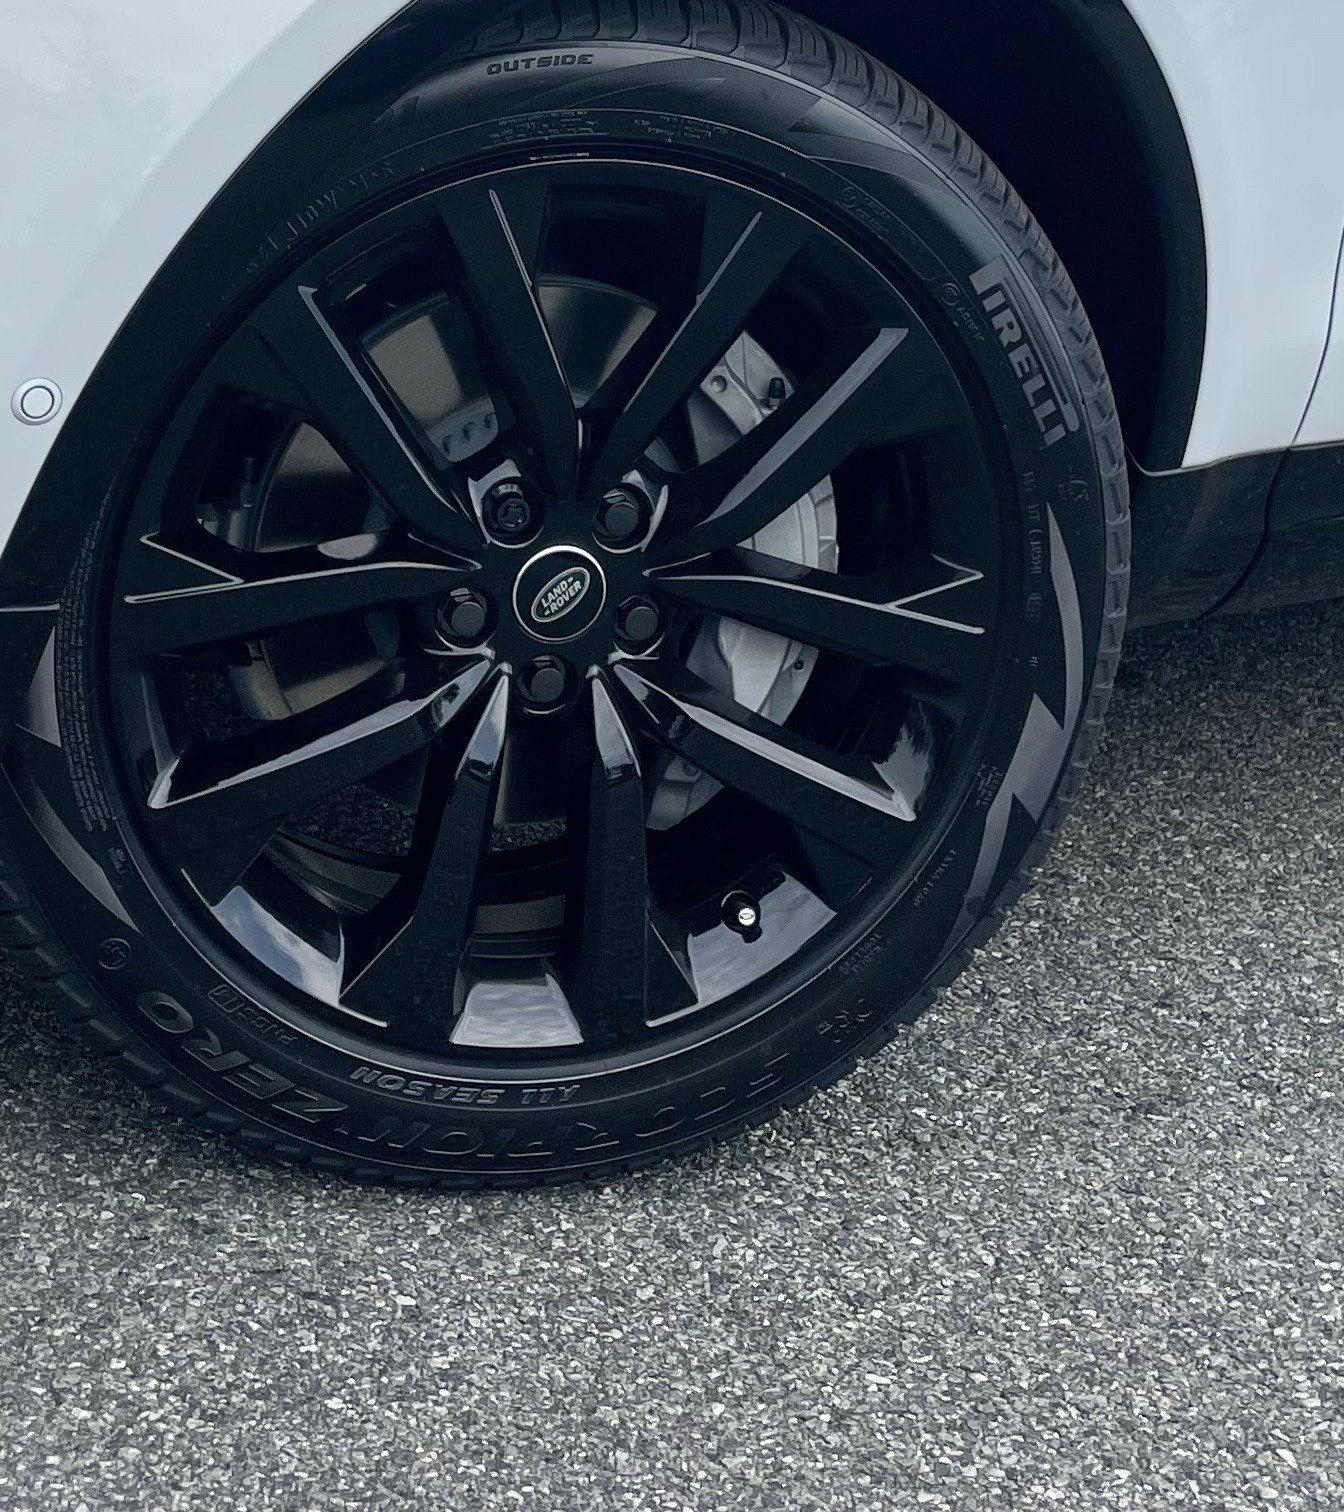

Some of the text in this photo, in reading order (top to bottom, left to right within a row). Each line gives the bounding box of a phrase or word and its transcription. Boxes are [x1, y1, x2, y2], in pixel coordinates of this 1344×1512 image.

[486, 53, 594, 76] OUTSIDE
[968, 253, 1080, 447] PIRELLI
[136, 990, 348, 1124] ZERO
[349, 1064, 582, 1106] ALL SEASON
